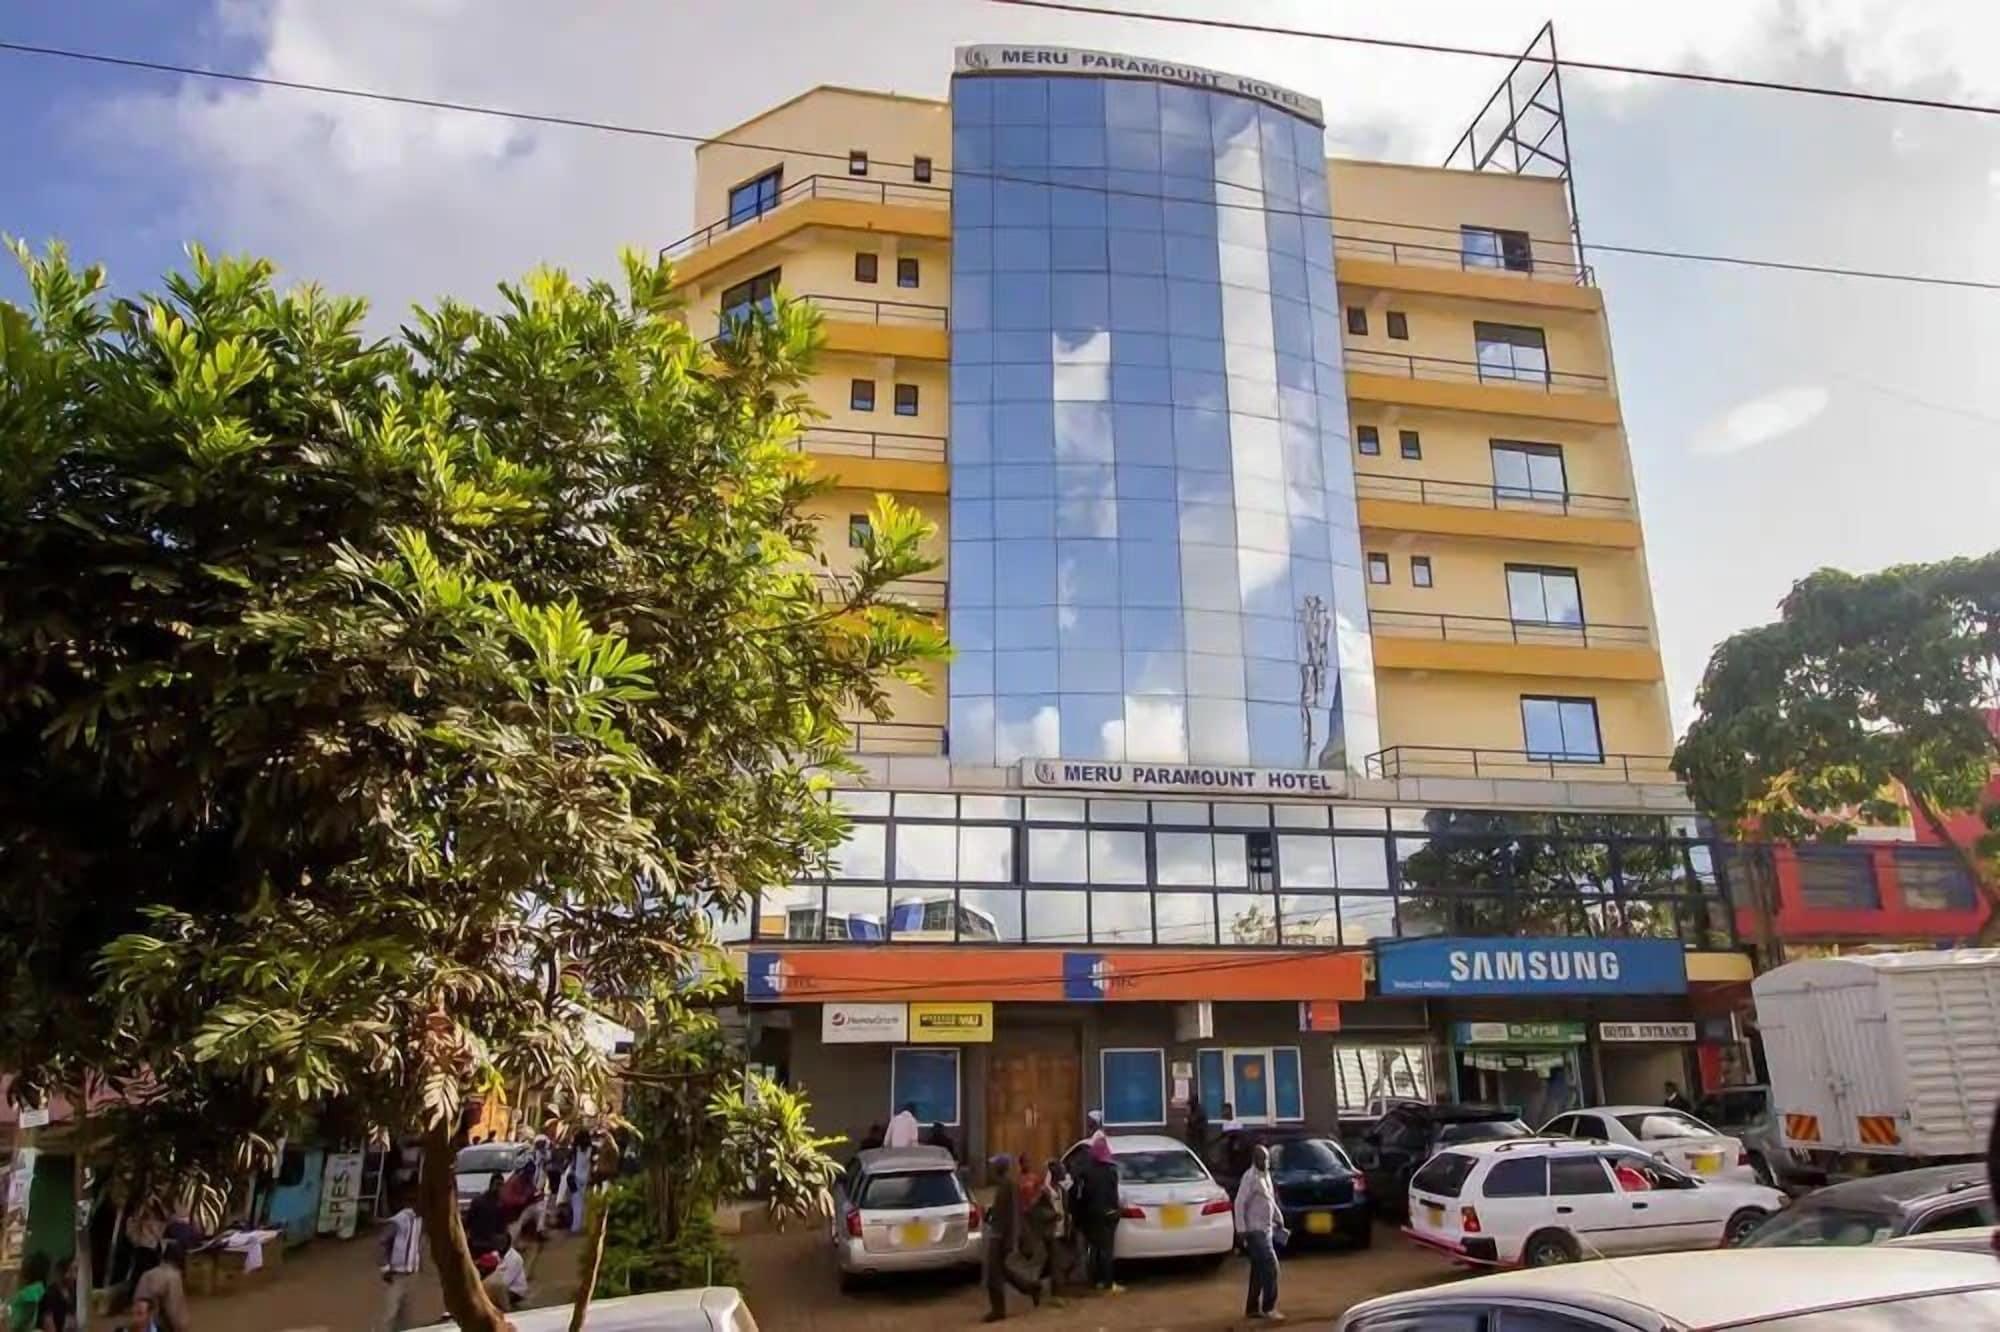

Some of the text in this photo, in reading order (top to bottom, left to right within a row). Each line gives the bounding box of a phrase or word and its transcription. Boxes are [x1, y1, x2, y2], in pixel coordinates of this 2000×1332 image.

[1001, 50, 1304, 108] MERU PARAMOUNT HOTEL
[1063, 764, 1333, 791] MERU PARAMOUNT HOTEL
[1450, 950, 1620, 982] SAMSUNG
[1602, 1025, 1689, 1039] HOTEL ENTRANCE
